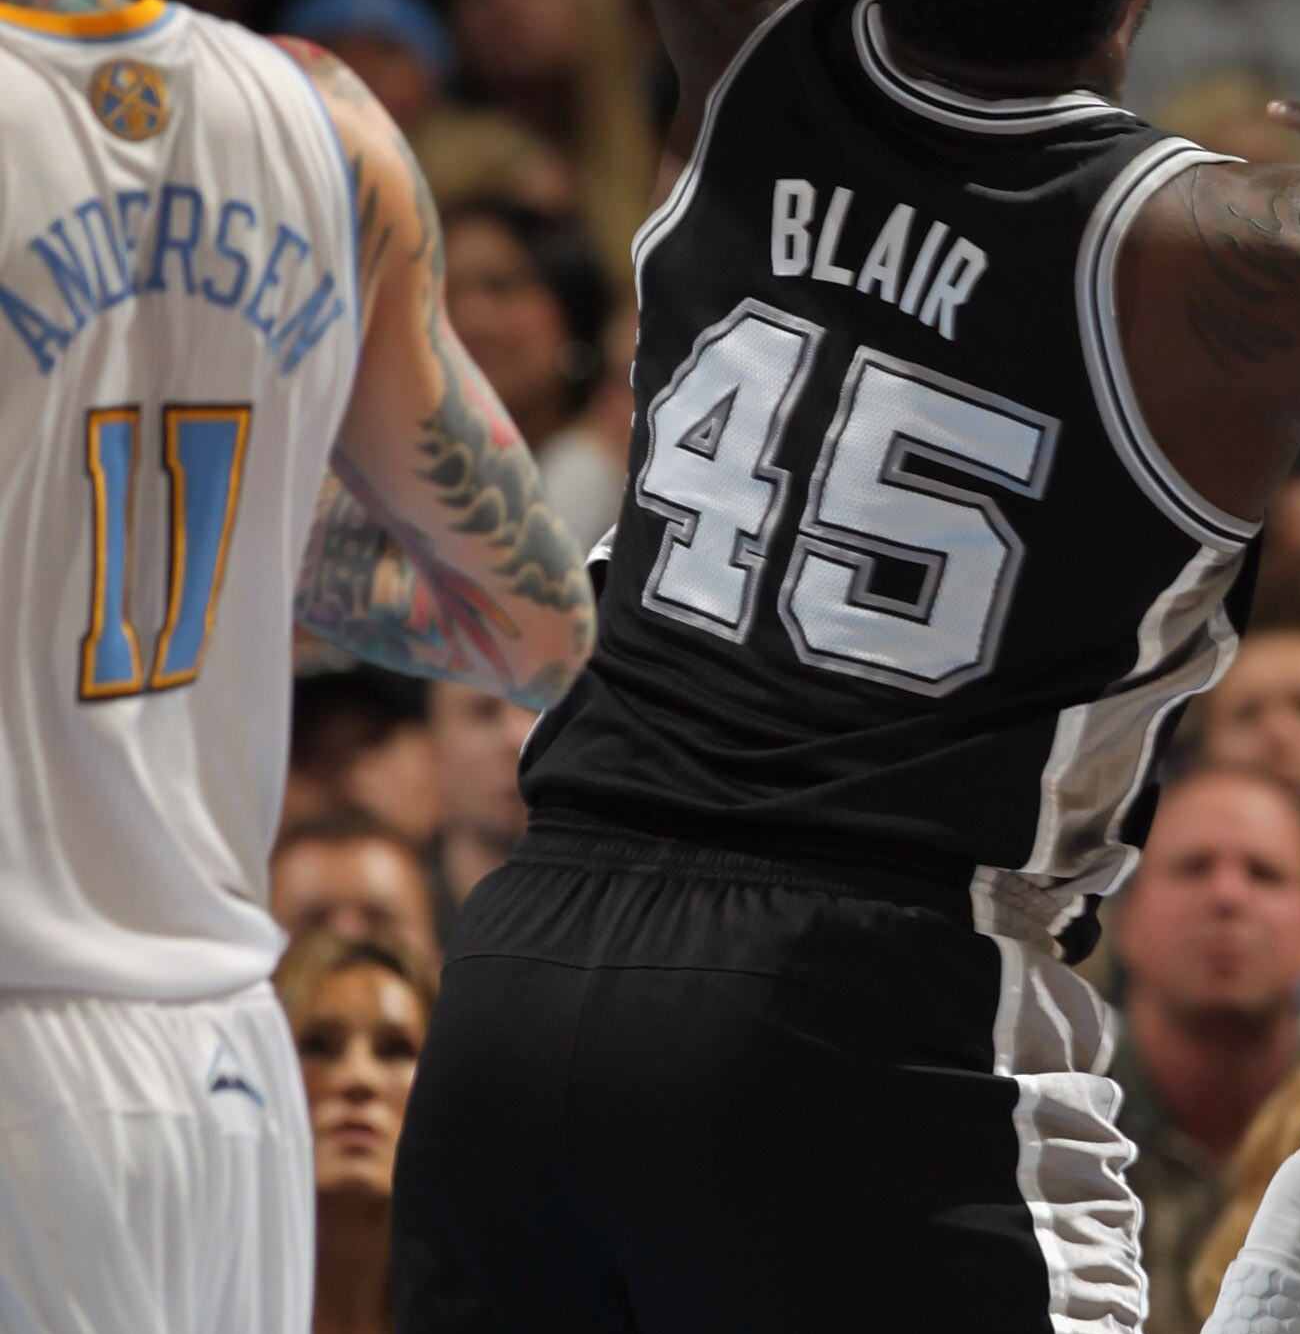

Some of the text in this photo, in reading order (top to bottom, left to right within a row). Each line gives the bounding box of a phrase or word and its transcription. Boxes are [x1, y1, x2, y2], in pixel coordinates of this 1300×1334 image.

[0, 183, 344, 375] ANDERSEN
[771, 178, 988, 341] BLAIR
[636, 297, 1062, 698] 45
